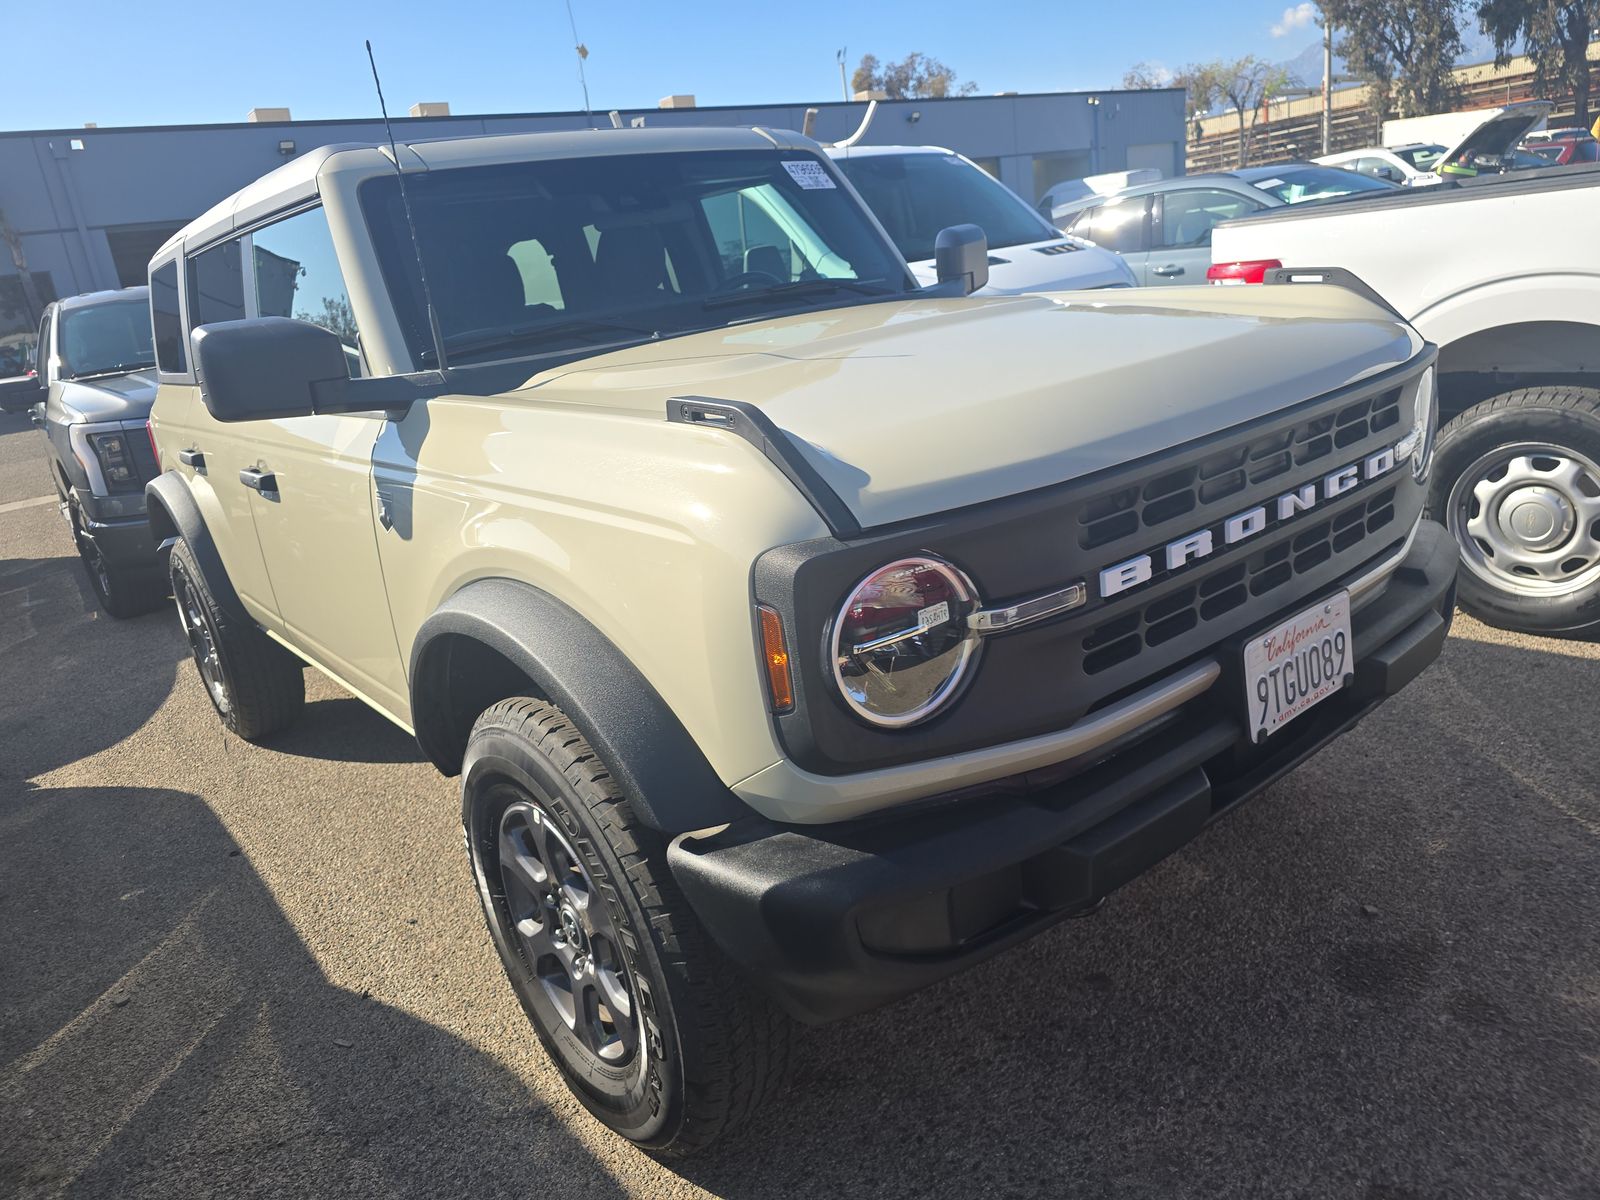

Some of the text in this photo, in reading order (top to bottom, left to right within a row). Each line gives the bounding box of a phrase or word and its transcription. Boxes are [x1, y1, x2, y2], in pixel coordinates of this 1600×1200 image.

[1099, 448, 1394, 598] BRONCO
[1256, 631, 1346, 726] 9TGU089
[1266, 615, 1331, 662] California
[1278, 685, 1331, 722] dmv.ca.gov
[550, 797, 667, 1061] DUELER
